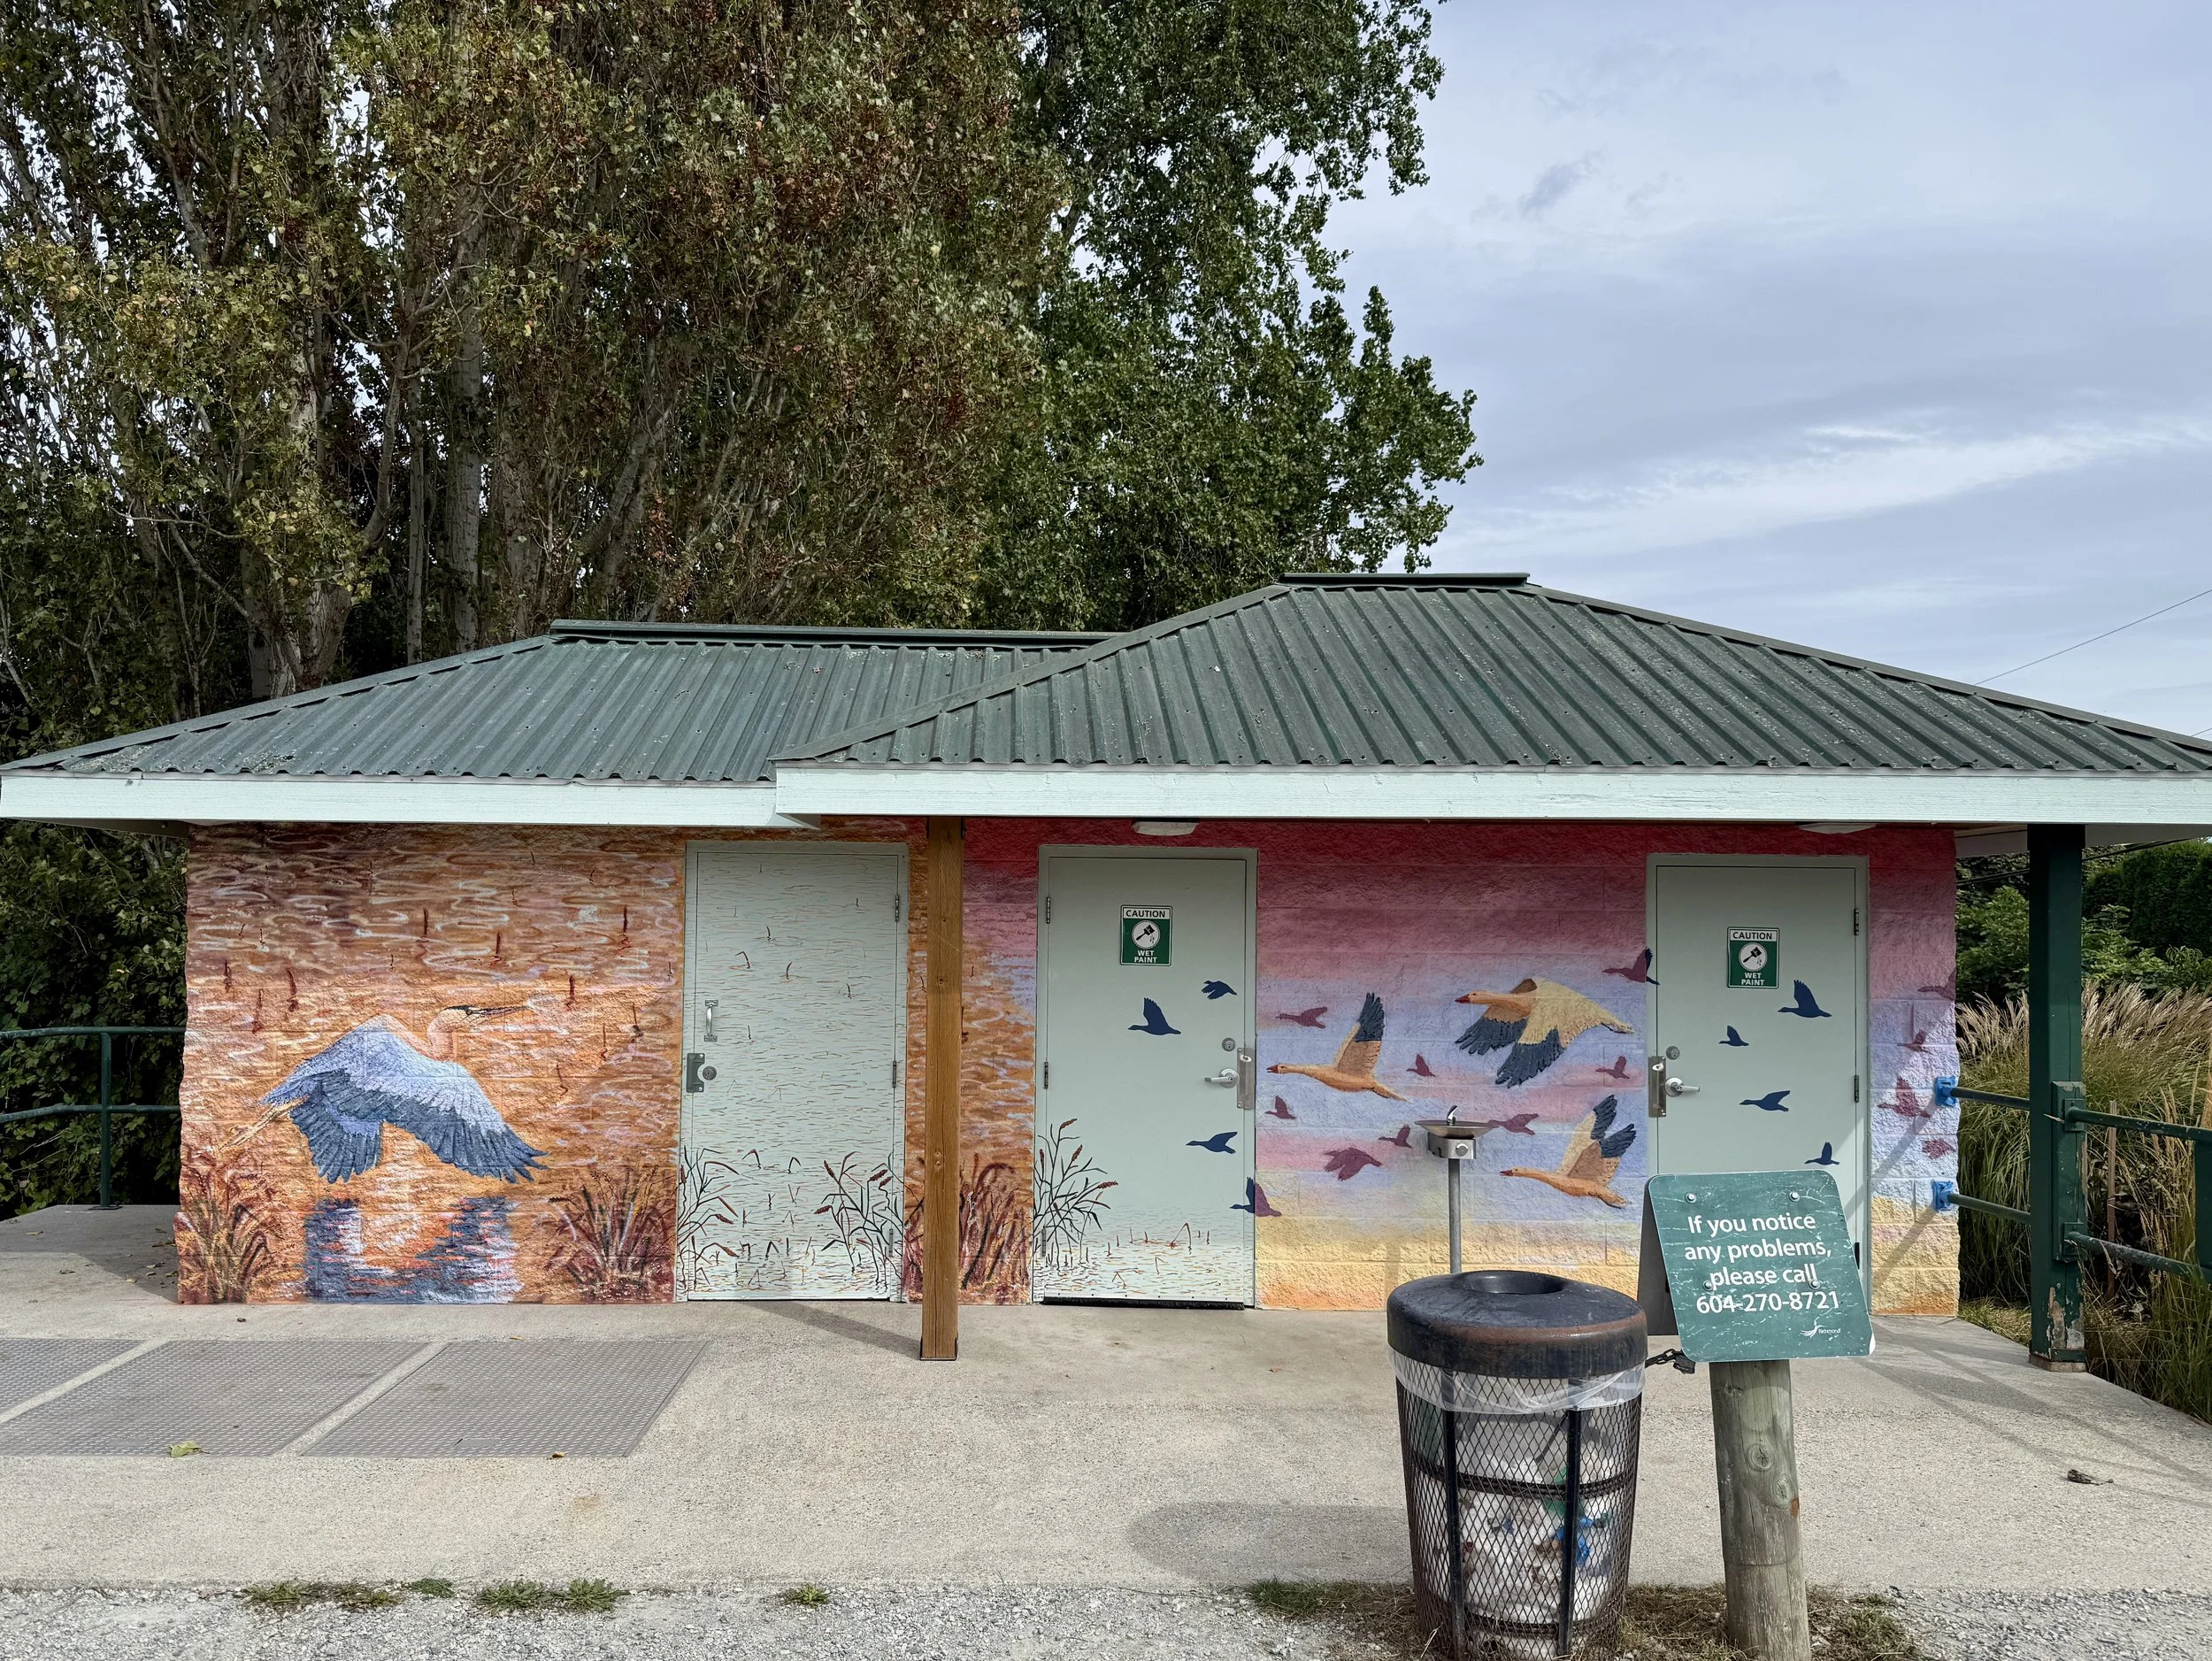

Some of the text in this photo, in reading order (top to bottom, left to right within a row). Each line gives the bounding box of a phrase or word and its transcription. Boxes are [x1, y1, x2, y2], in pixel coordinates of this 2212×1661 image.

[1687, 1212, 1816, 1237] If you notice
[1685, 1239, 1832, 1264] any problems,
[1709, 1264, 1818, 1290] please call
[1696, 1291, 1839, 1314] 604-270-8721
